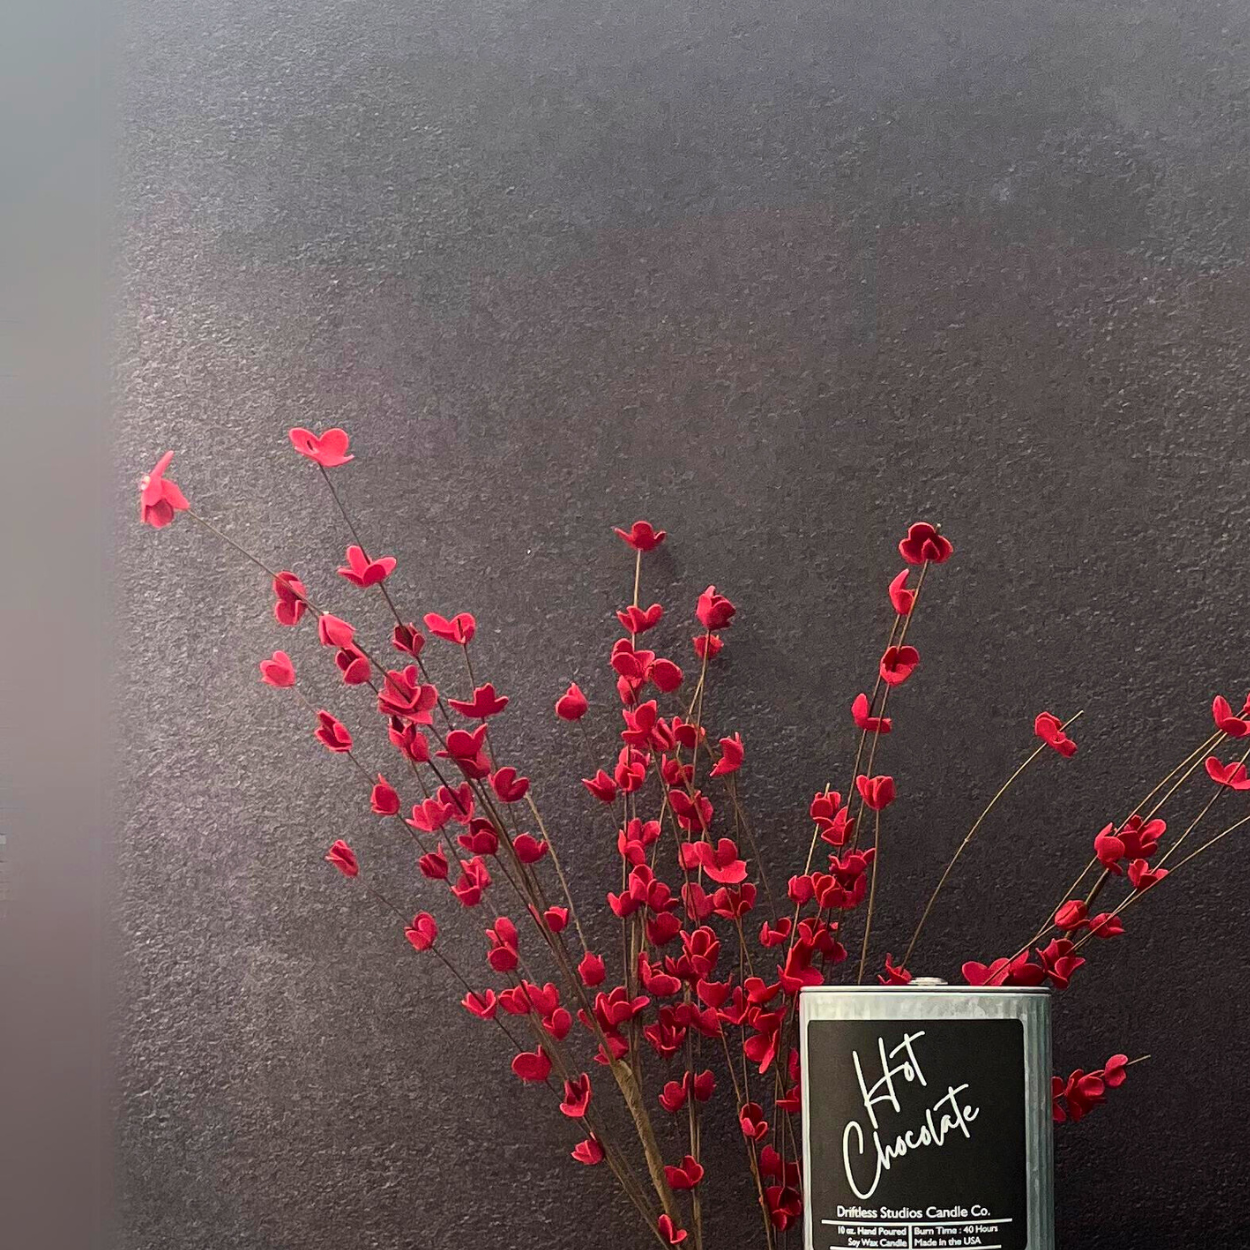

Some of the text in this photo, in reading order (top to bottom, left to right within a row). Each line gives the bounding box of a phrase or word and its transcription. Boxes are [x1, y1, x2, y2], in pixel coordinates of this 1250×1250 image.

[852, 1030, 927, 1130] Hot
[842, 1083, 980, 1200] Chocolate
[836, 1205, 991, 1219] Driftless Studios Candle Co.
[914, 1225, 998, 1235] Burn Time 40 Hours
[861, 1238, 878, 1247] Wax
[879, 1239, 907, 1247] Candle
[914, 1236, 982, 1247] Made in the USA
